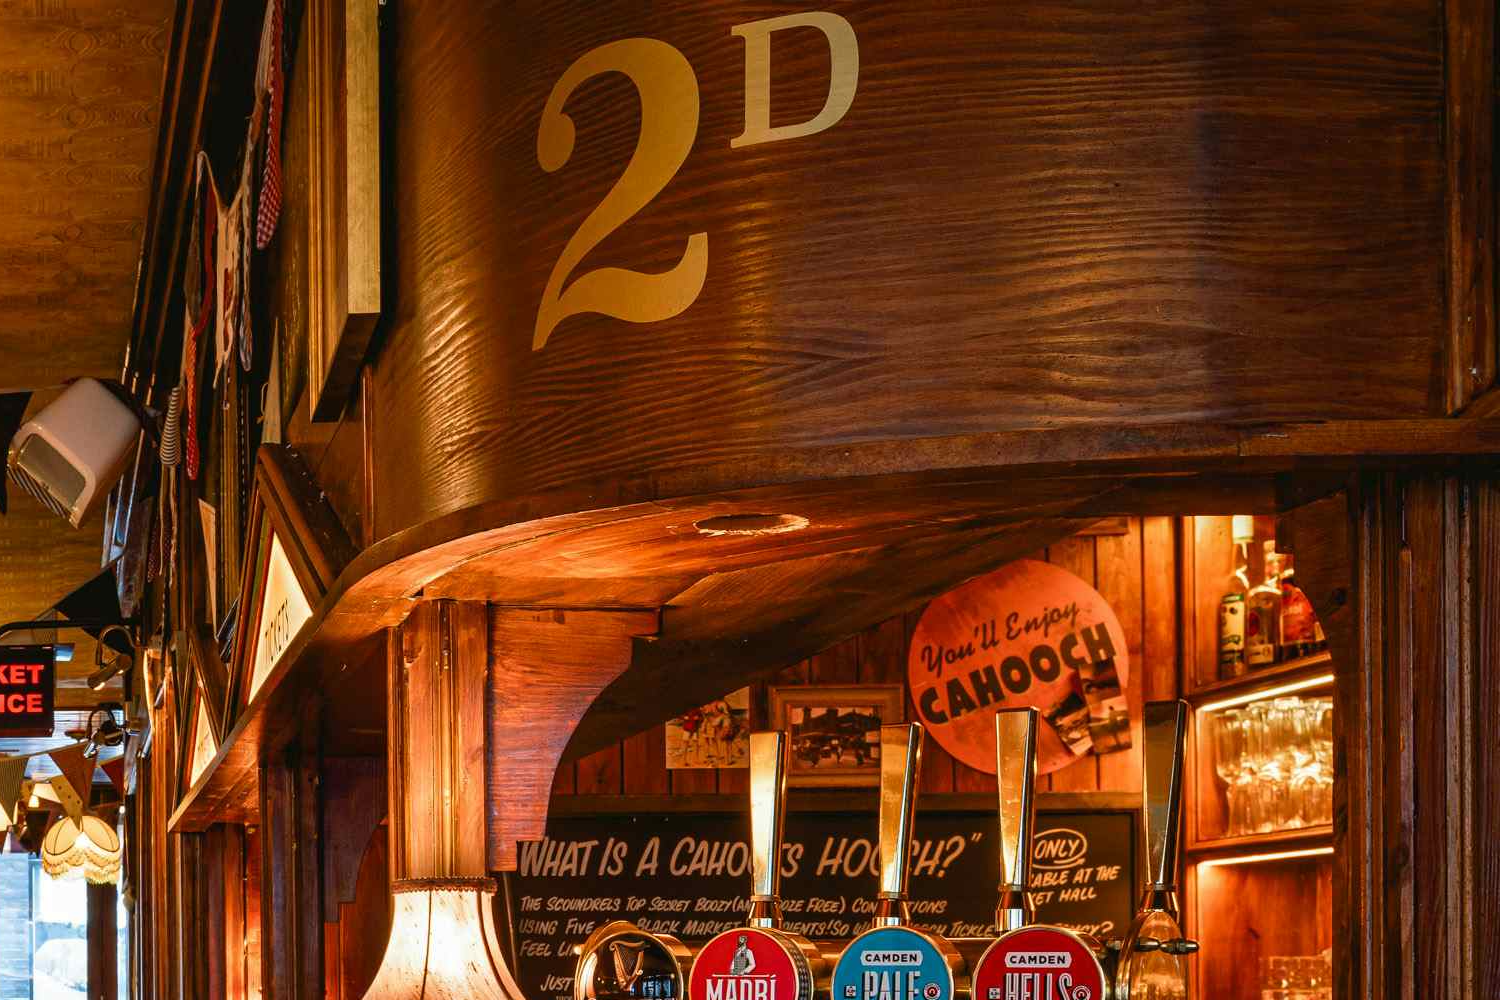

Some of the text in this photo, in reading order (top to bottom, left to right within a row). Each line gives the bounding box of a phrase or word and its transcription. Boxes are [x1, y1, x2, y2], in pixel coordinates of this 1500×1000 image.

[921, 602, 1080, 676] You'll Enjoy
[920, 622, 1116, 724] CAHOOCH
[519, 836, 599, 877] WHAT
[598, 836, 629, 877] IS
[635, 836, 660, 877] A
[670, 836, 804, 877] CAHOS
[1035, 839, 1080, 860] ONLY
[1073, 865, 1121, 884] AT THE
[1059, 887, 1097, 902] HALL
[519, 895, 542, 912] THE
[546, 895, 620, 912] SCOUNDRELS
[626, 895, 646, 912] TOP
[648, 896, 691, 912] SECRET
[806, 896, 847, 914] FREE)
[519, 918, 558, 935] USING
[564, 917, 595, 935] FIVE
[635, 917, 679, 934] BLACK
[519, 941, 552, 956] FEEL
[865, 954, 917, 962] CAMDEN
[1009, 955, 1066, 964] CAMDEN
[540, 974, 573, 991] JUST
